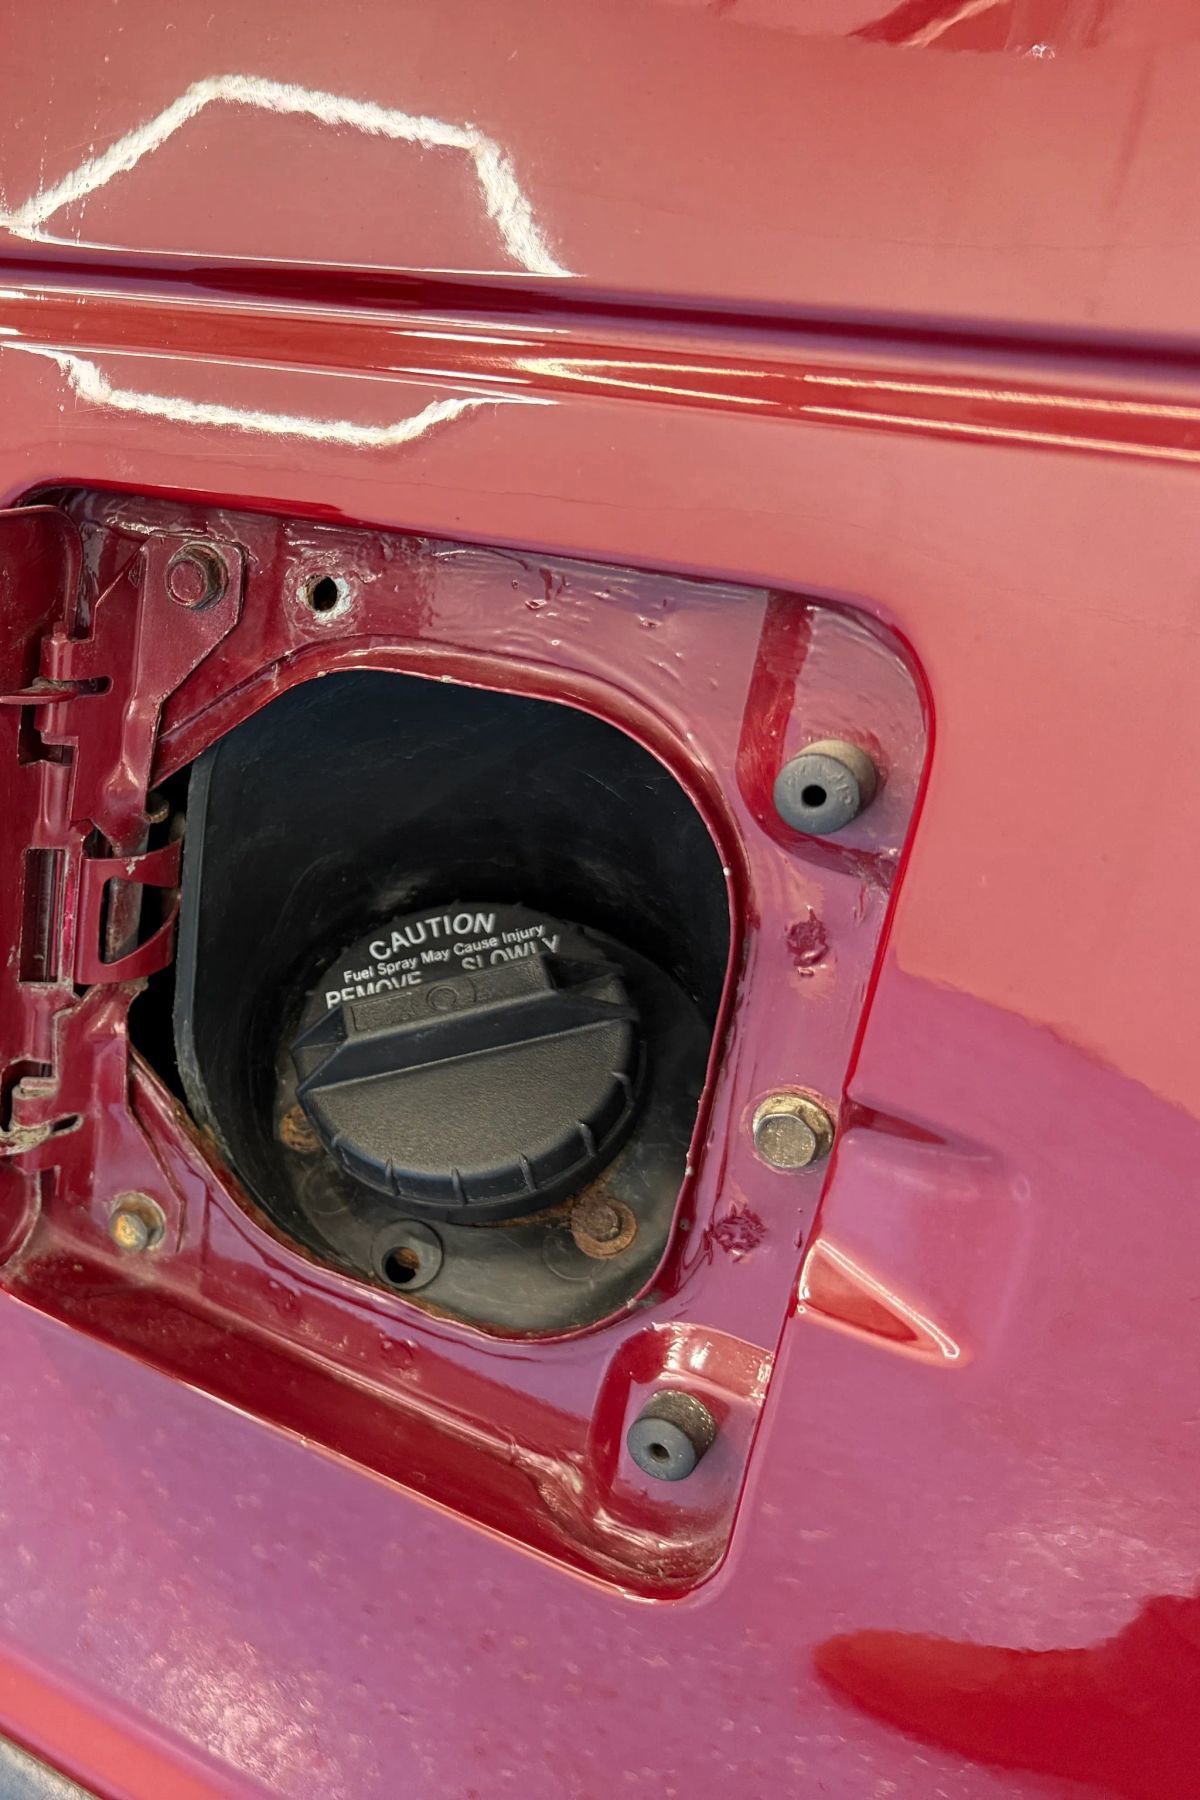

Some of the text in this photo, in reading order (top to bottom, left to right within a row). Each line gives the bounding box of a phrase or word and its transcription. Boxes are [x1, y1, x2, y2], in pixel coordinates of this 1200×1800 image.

[343, 924, 544, 984] Fuel Spray May Cause Injury
[369, 913, 496, 960] CAUTION
